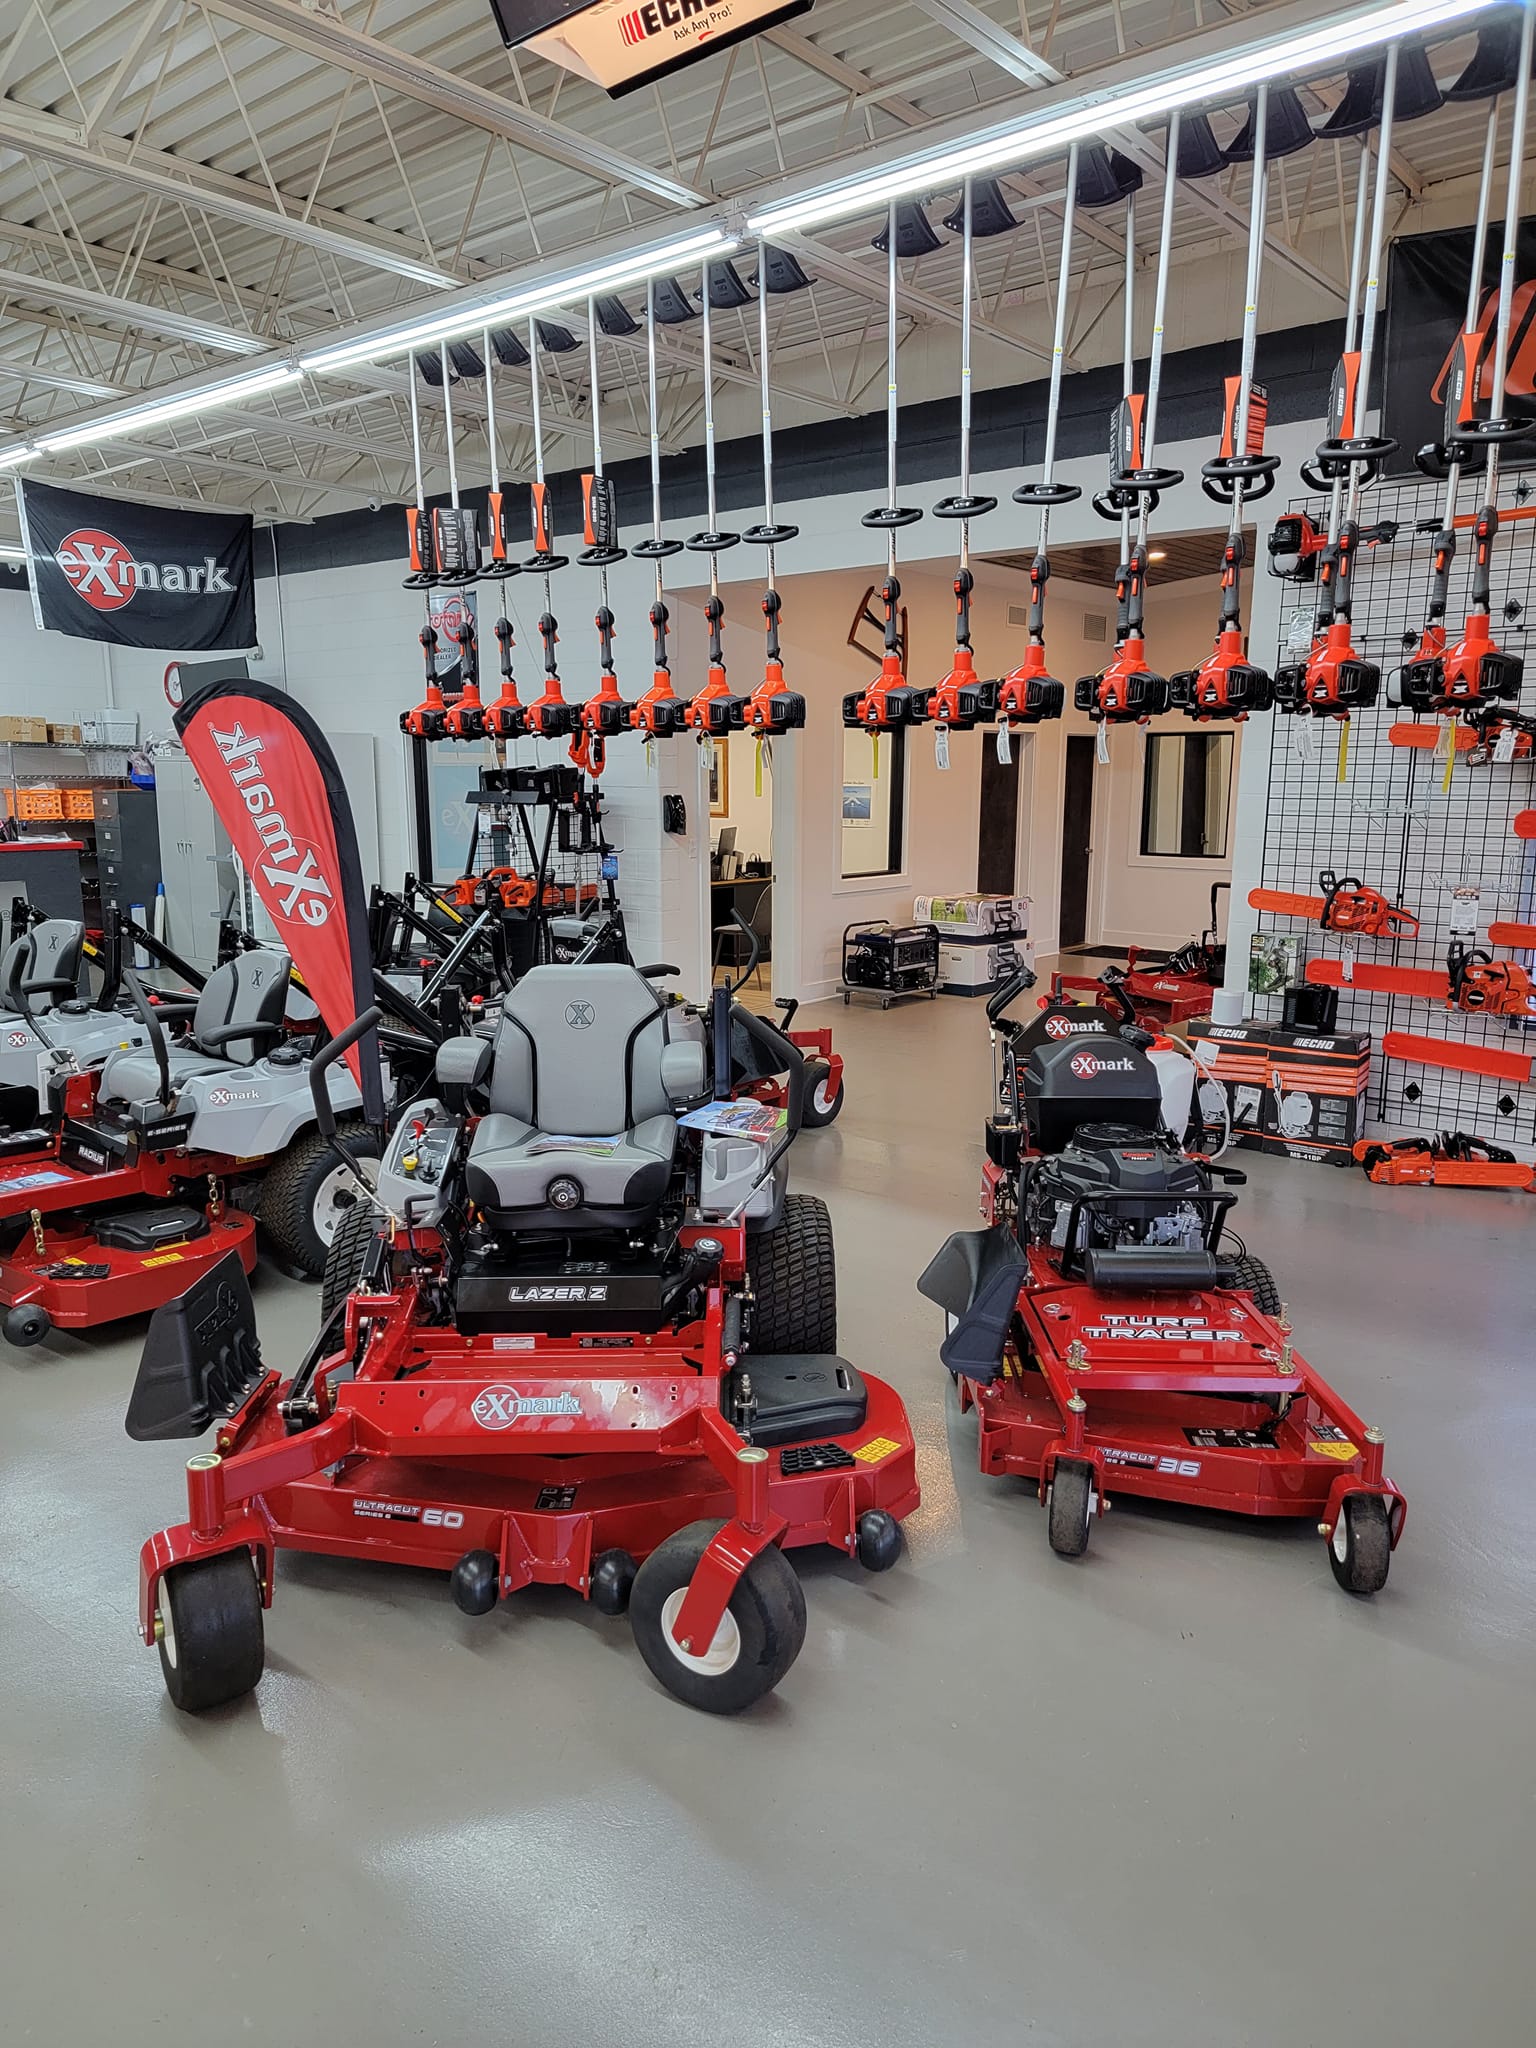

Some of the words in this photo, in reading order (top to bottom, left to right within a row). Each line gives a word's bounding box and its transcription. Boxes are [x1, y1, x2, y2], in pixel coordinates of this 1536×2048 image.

[640, 0, 724, 36] ECH
[673, 26, 691, 41] Ask
[692, 18, 710, 29] Any
[709, 6, 732, 23] Pro!
[1045, 1019, 1106, 1036] eXmark
[1215, 1028, 1248, 1039] ECHO
[1302, 1038, 1335, 1050] ECHO
[1071, 1057, 1136, 1075] eXmark
[209, 1089, 260, 1105] eXmark
[78, 1144, 105, 1166] RADIUS
[509, 1286, 586, 1302] LAZER
[588, 1286, 607, 1301] Z
[1102, 1315, 1208, 1327] TURF
[1082, 1327, 1248, 1342] TRACER
[1157, 1455, 1202, 1477] 36
[353, 1499, 421, 1516] ULTRACUT
[422, 1508, 464, 1529] 60
